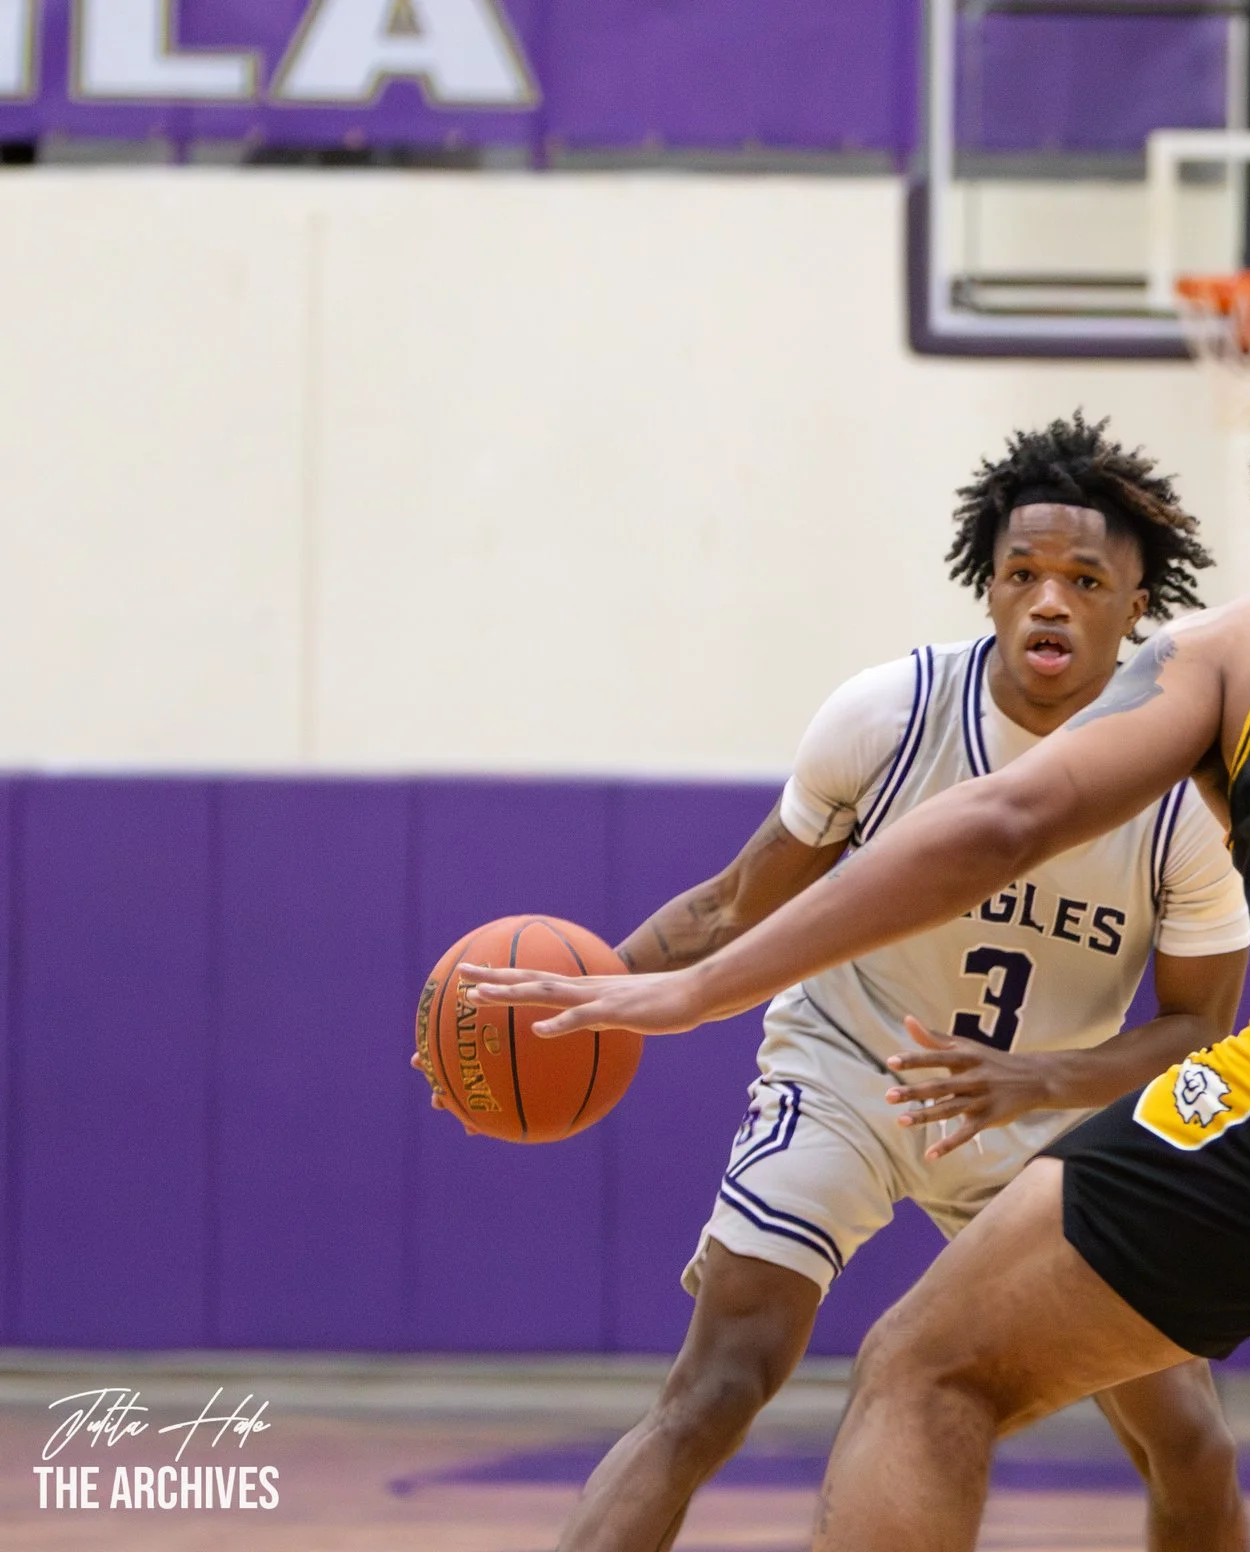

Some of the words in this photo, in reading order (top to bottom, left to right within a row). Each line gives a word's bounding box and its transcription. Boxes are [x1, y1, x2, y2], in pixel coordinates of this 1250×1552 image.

[0, 0, 542, 108] LA
[957, 878, 1126, 957] GLES
[456, 966, 502, 1113] ALDING
[950, 944, 1035, 1054] 3
